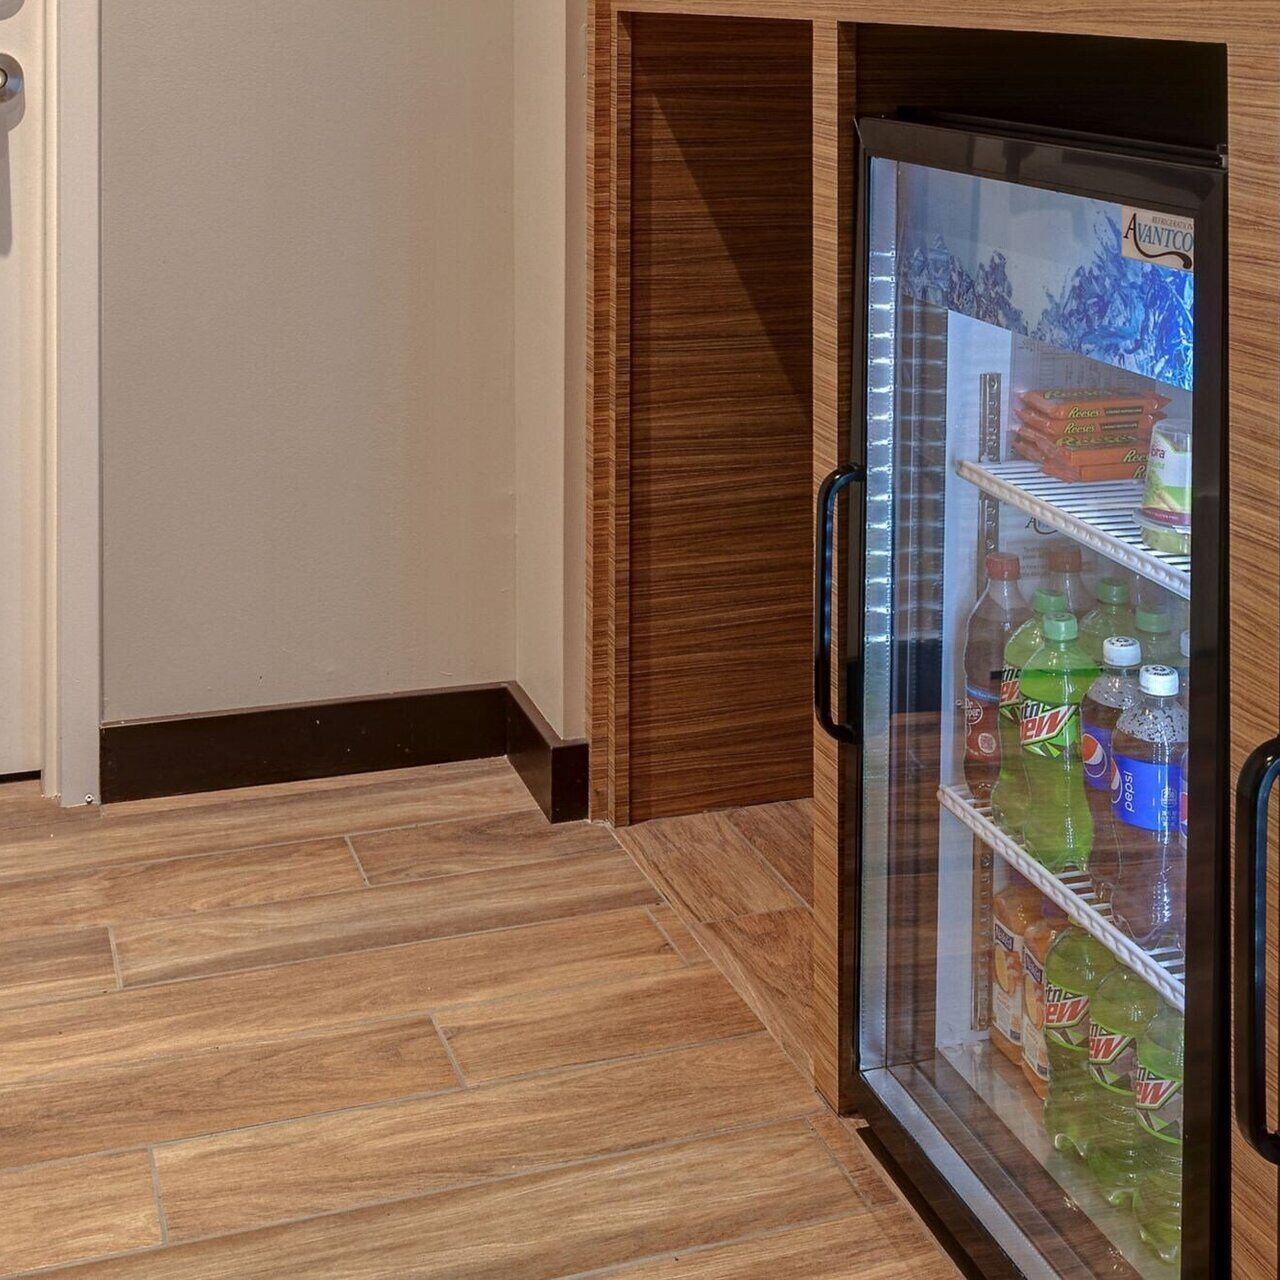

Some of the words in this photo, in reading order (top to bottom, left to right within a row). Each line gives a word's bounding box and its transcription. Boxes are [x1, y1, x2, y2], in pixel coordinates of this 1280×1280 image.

[1123, 213, 1193, 261] AVANTCO
[1022, 705, 1068, 741] ew
[1124, 770, 1135, 814] pepsi
